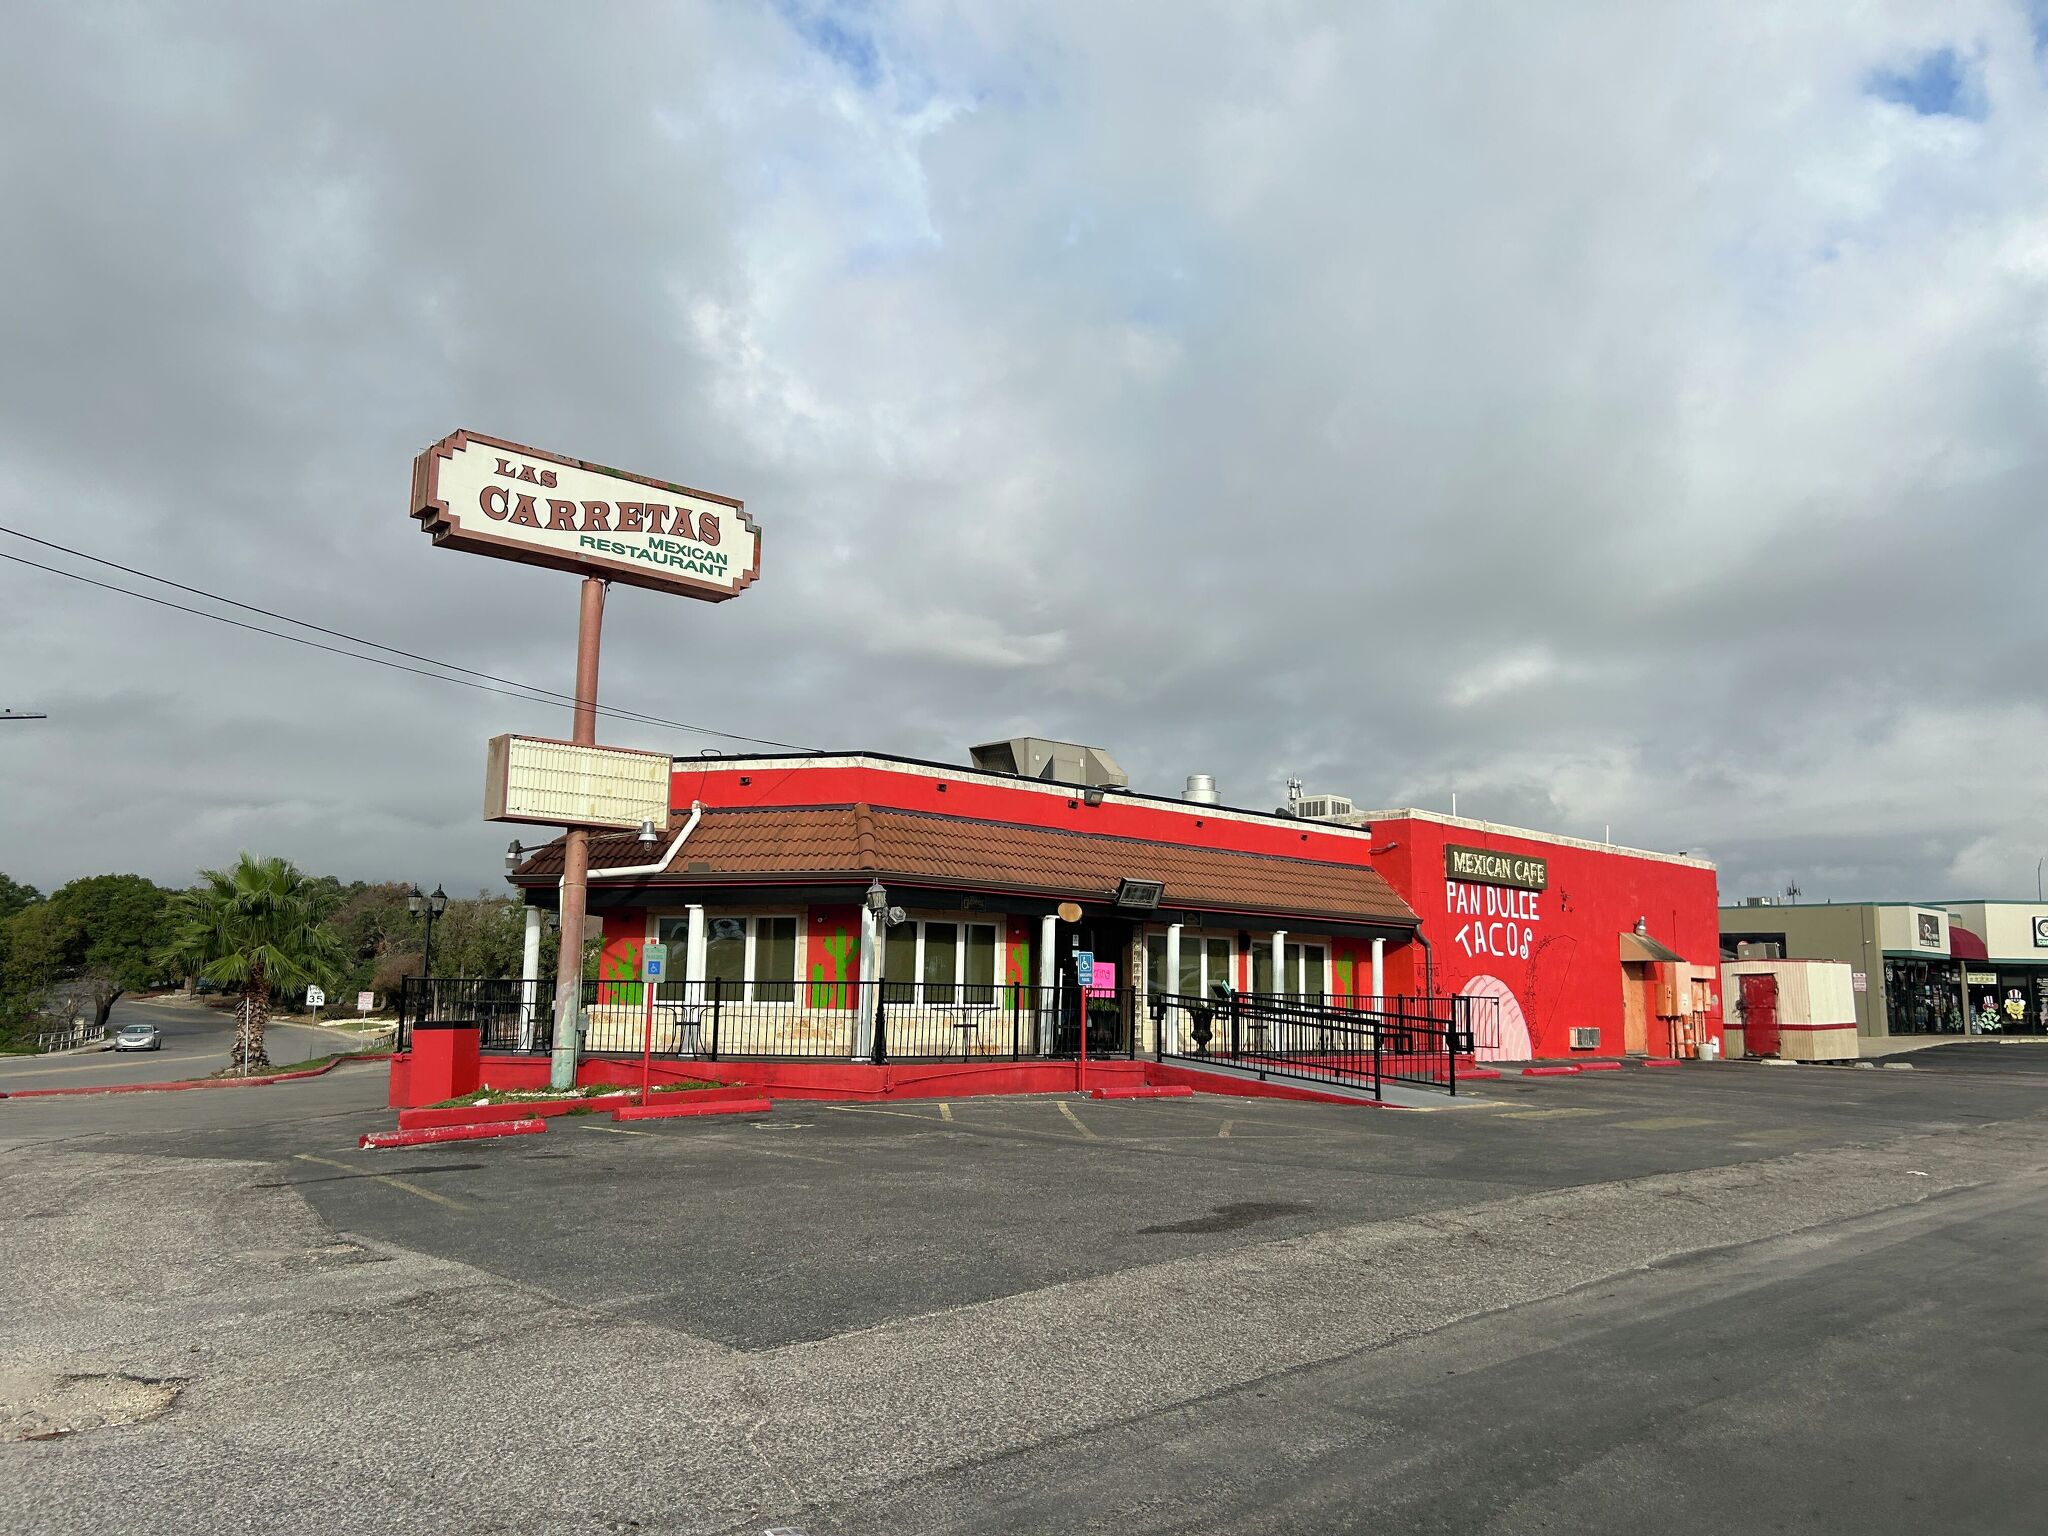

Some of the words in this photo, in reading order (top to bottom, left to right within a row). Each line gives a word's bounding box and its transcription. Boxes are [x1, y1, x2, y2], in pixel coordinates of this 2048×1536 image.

[494, 457, 558, 489] LAS
[479, 485, 721, 547] CARRETAS
[579, 535, 728, 578] RESTAURANT
[648, 536, 728, 566] MEXICAN
[1453, 851, 1511, 879] MEXICAN
[1514, 860, 1545, 886] CAFE
[1446, 881, 1481, 916] PAN
[1486, 886, 1540, 921] DULCE
[1454, 920, 1533, 960] TACOS
[308, 995, 323, 1003] 35
